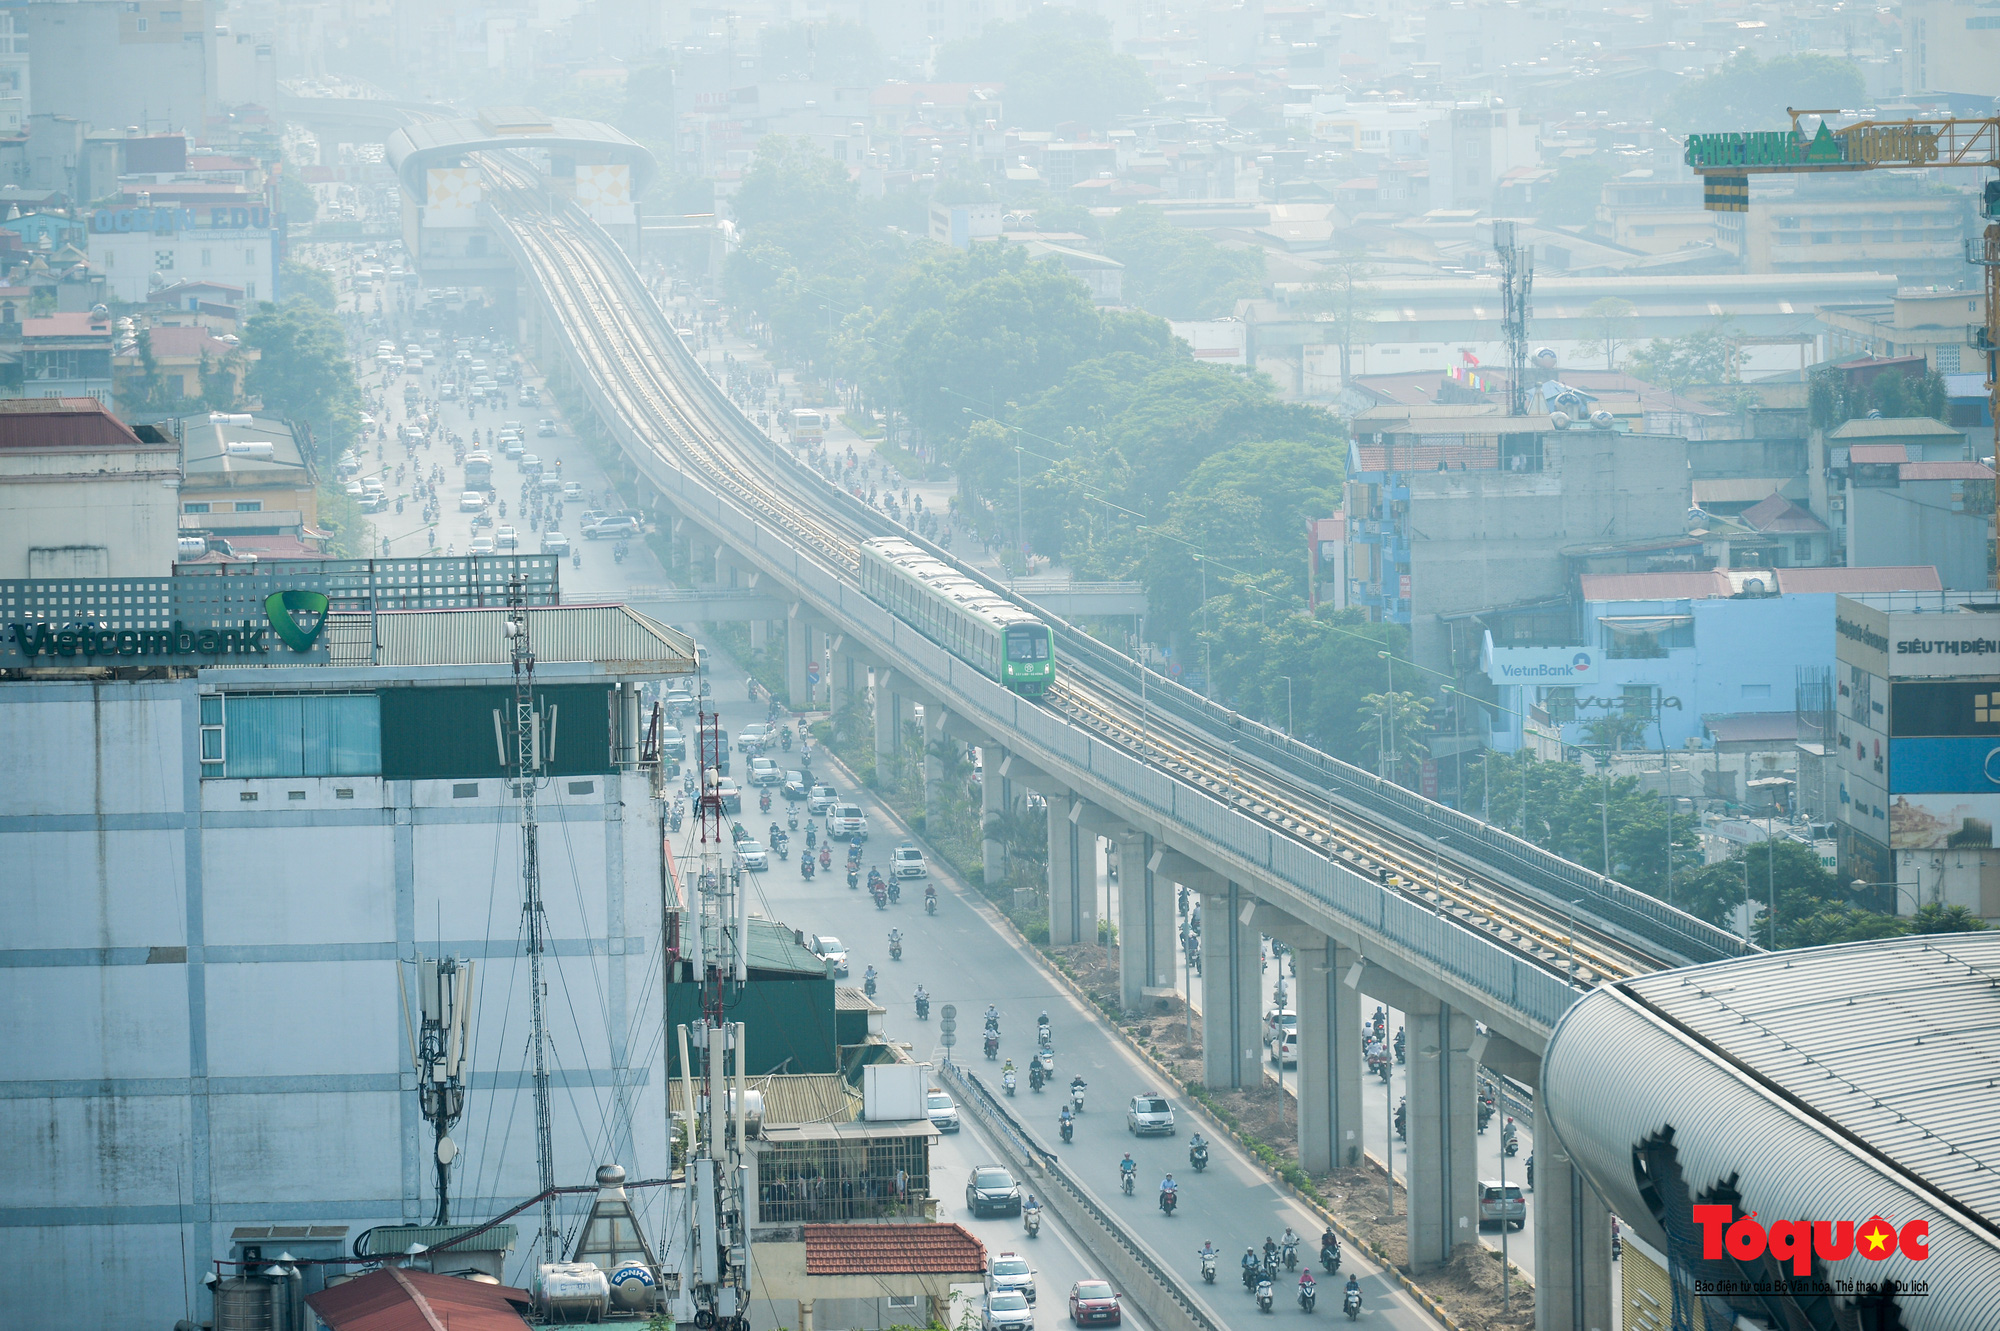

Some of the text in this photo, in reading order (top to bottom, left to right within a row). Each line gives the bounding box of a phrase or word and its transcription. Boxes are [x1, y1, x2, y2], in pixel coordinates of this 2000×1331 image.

[94, 207, 270, 232] OCEAN EDU
[15, 620, 267, 657] Vietcombank
[1897, 638, 1933, 654] SIÊU
[1934, 640, 1959, 656] THỊ
[1501, 664, 1574, 677] VietinBank
